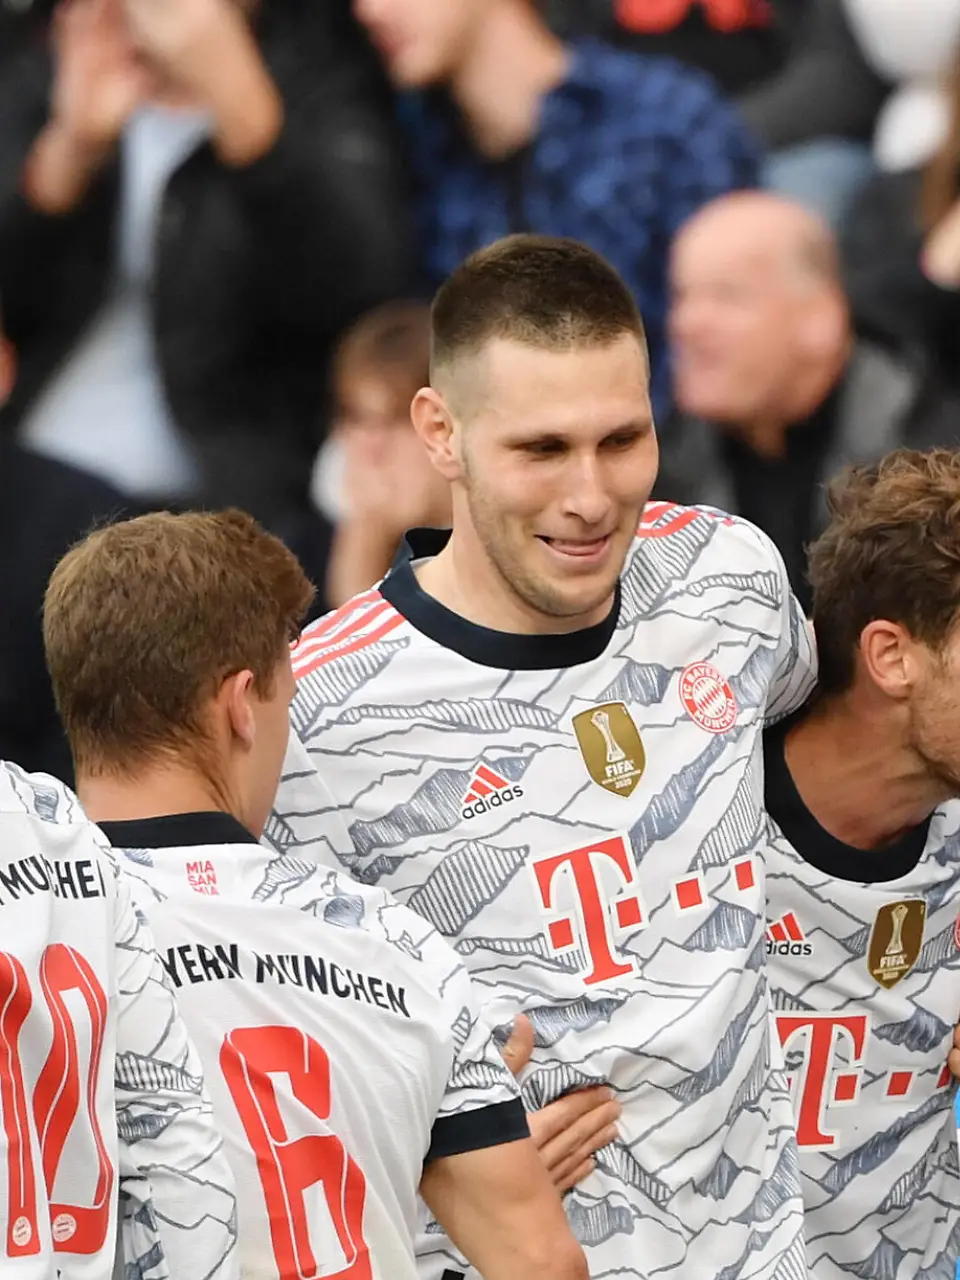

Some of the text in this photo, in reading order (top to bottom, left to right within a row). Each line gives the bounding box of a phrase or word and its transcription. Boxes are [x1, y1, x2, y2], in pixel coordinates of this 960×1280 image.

[605, 760, 634, 778] FIFA
[462, 785, 524, 819] adidas
[186, 860, 214, 873] MIA
[188, 873, 217, 886] SAN
[252, 951, 411, 1018] MÜNCHEN
